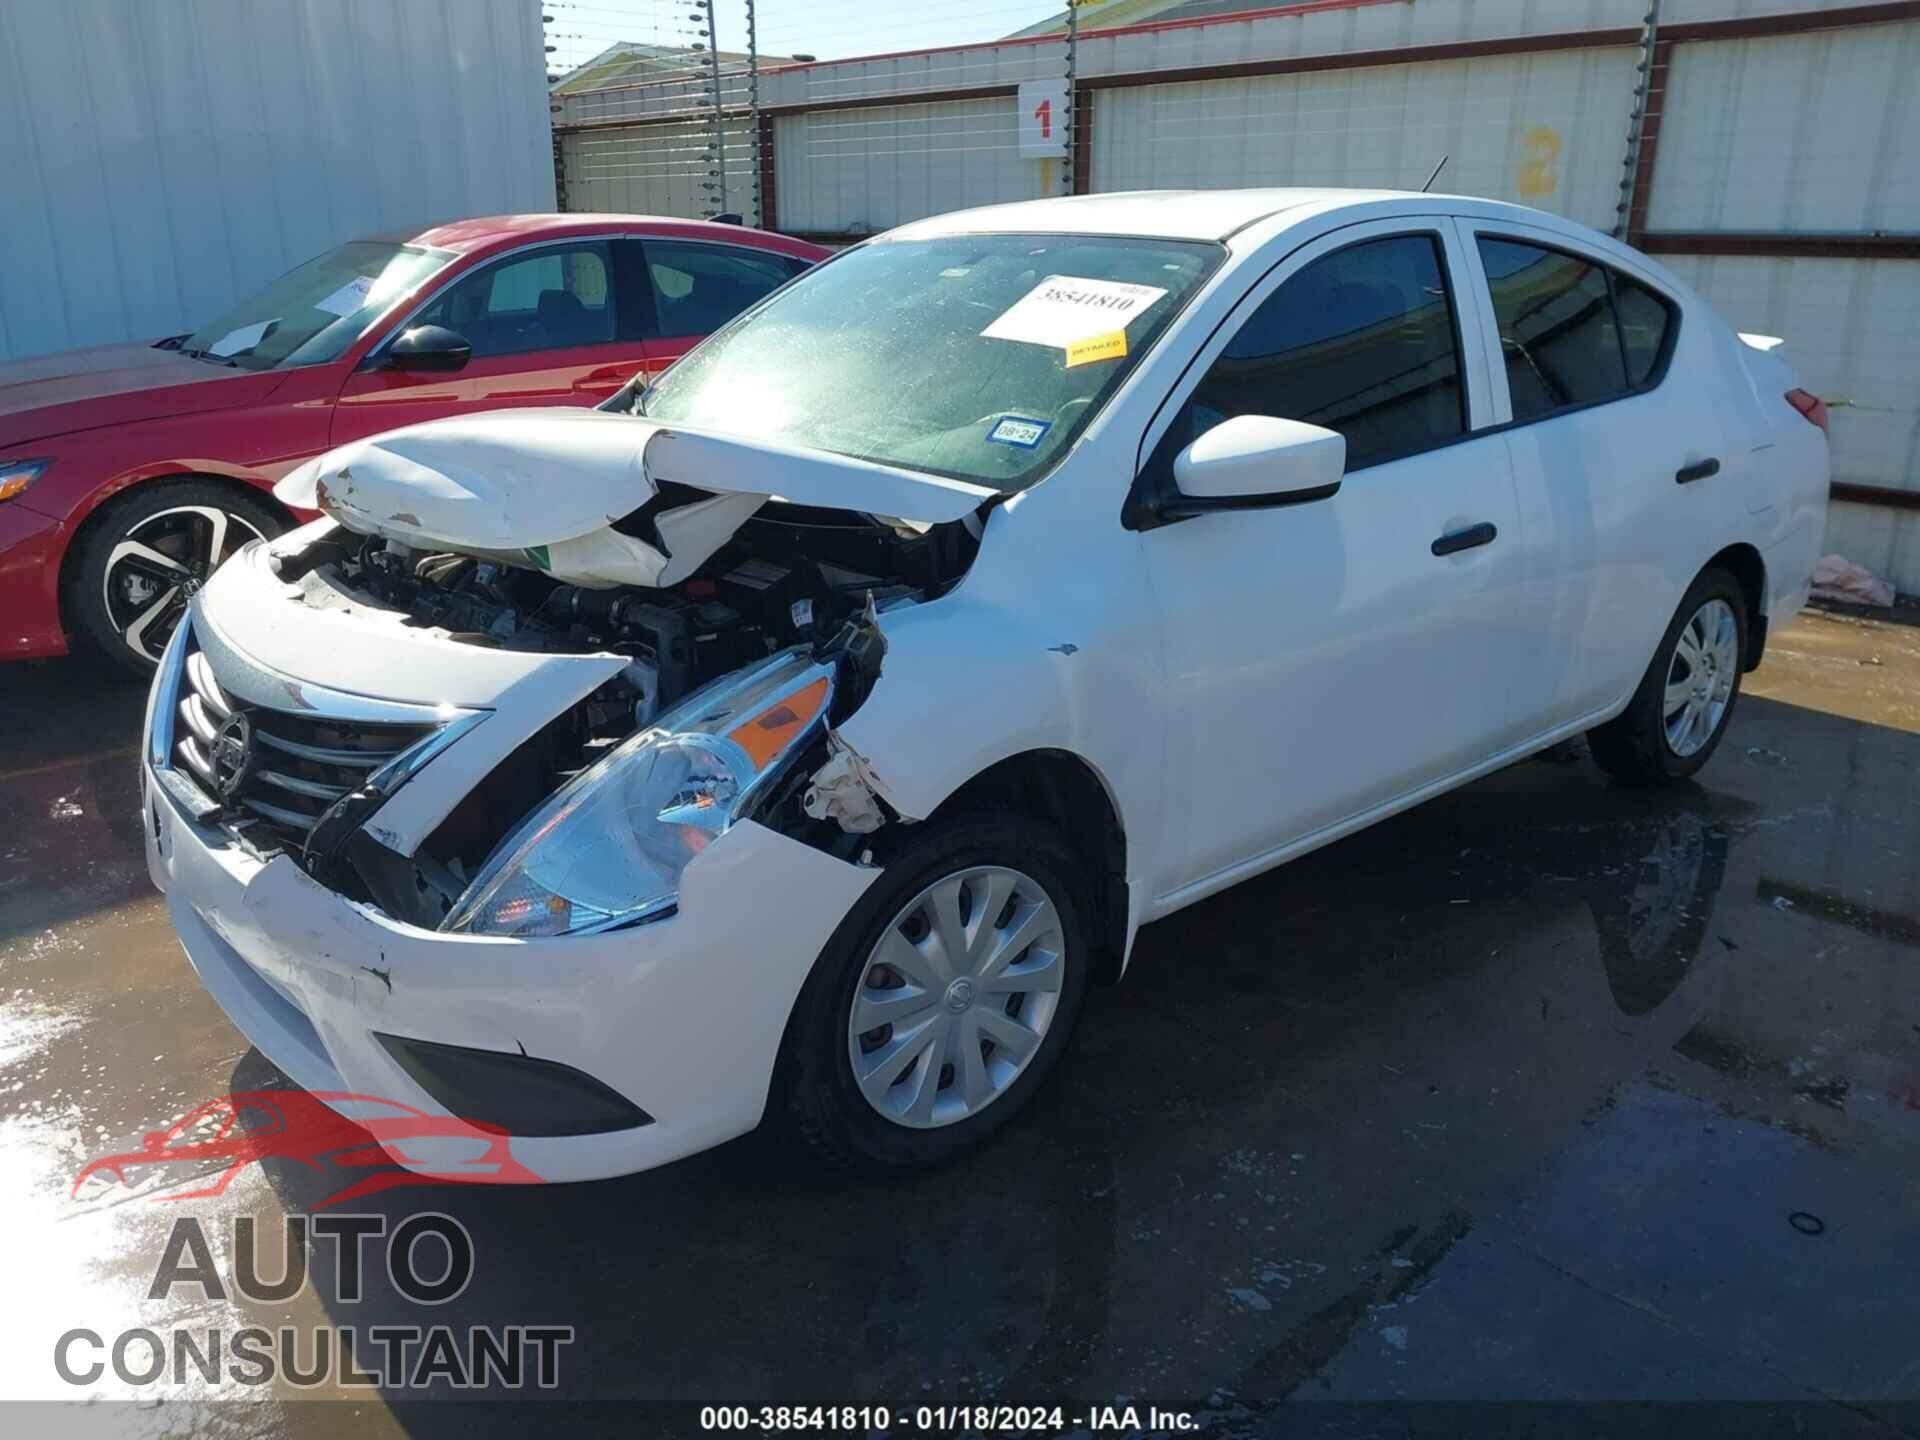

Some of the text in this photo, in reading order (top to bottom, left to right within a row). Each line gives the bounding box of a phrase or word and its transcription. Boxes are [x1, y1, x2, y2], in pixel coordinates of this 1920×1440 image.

[1034, 98, 1050, 139] 1
[1518, 127, 1563, 195] 2
[1038, 287, 1136, 311] 38541810
[1071, 339, 1122, 356] DETAILED
